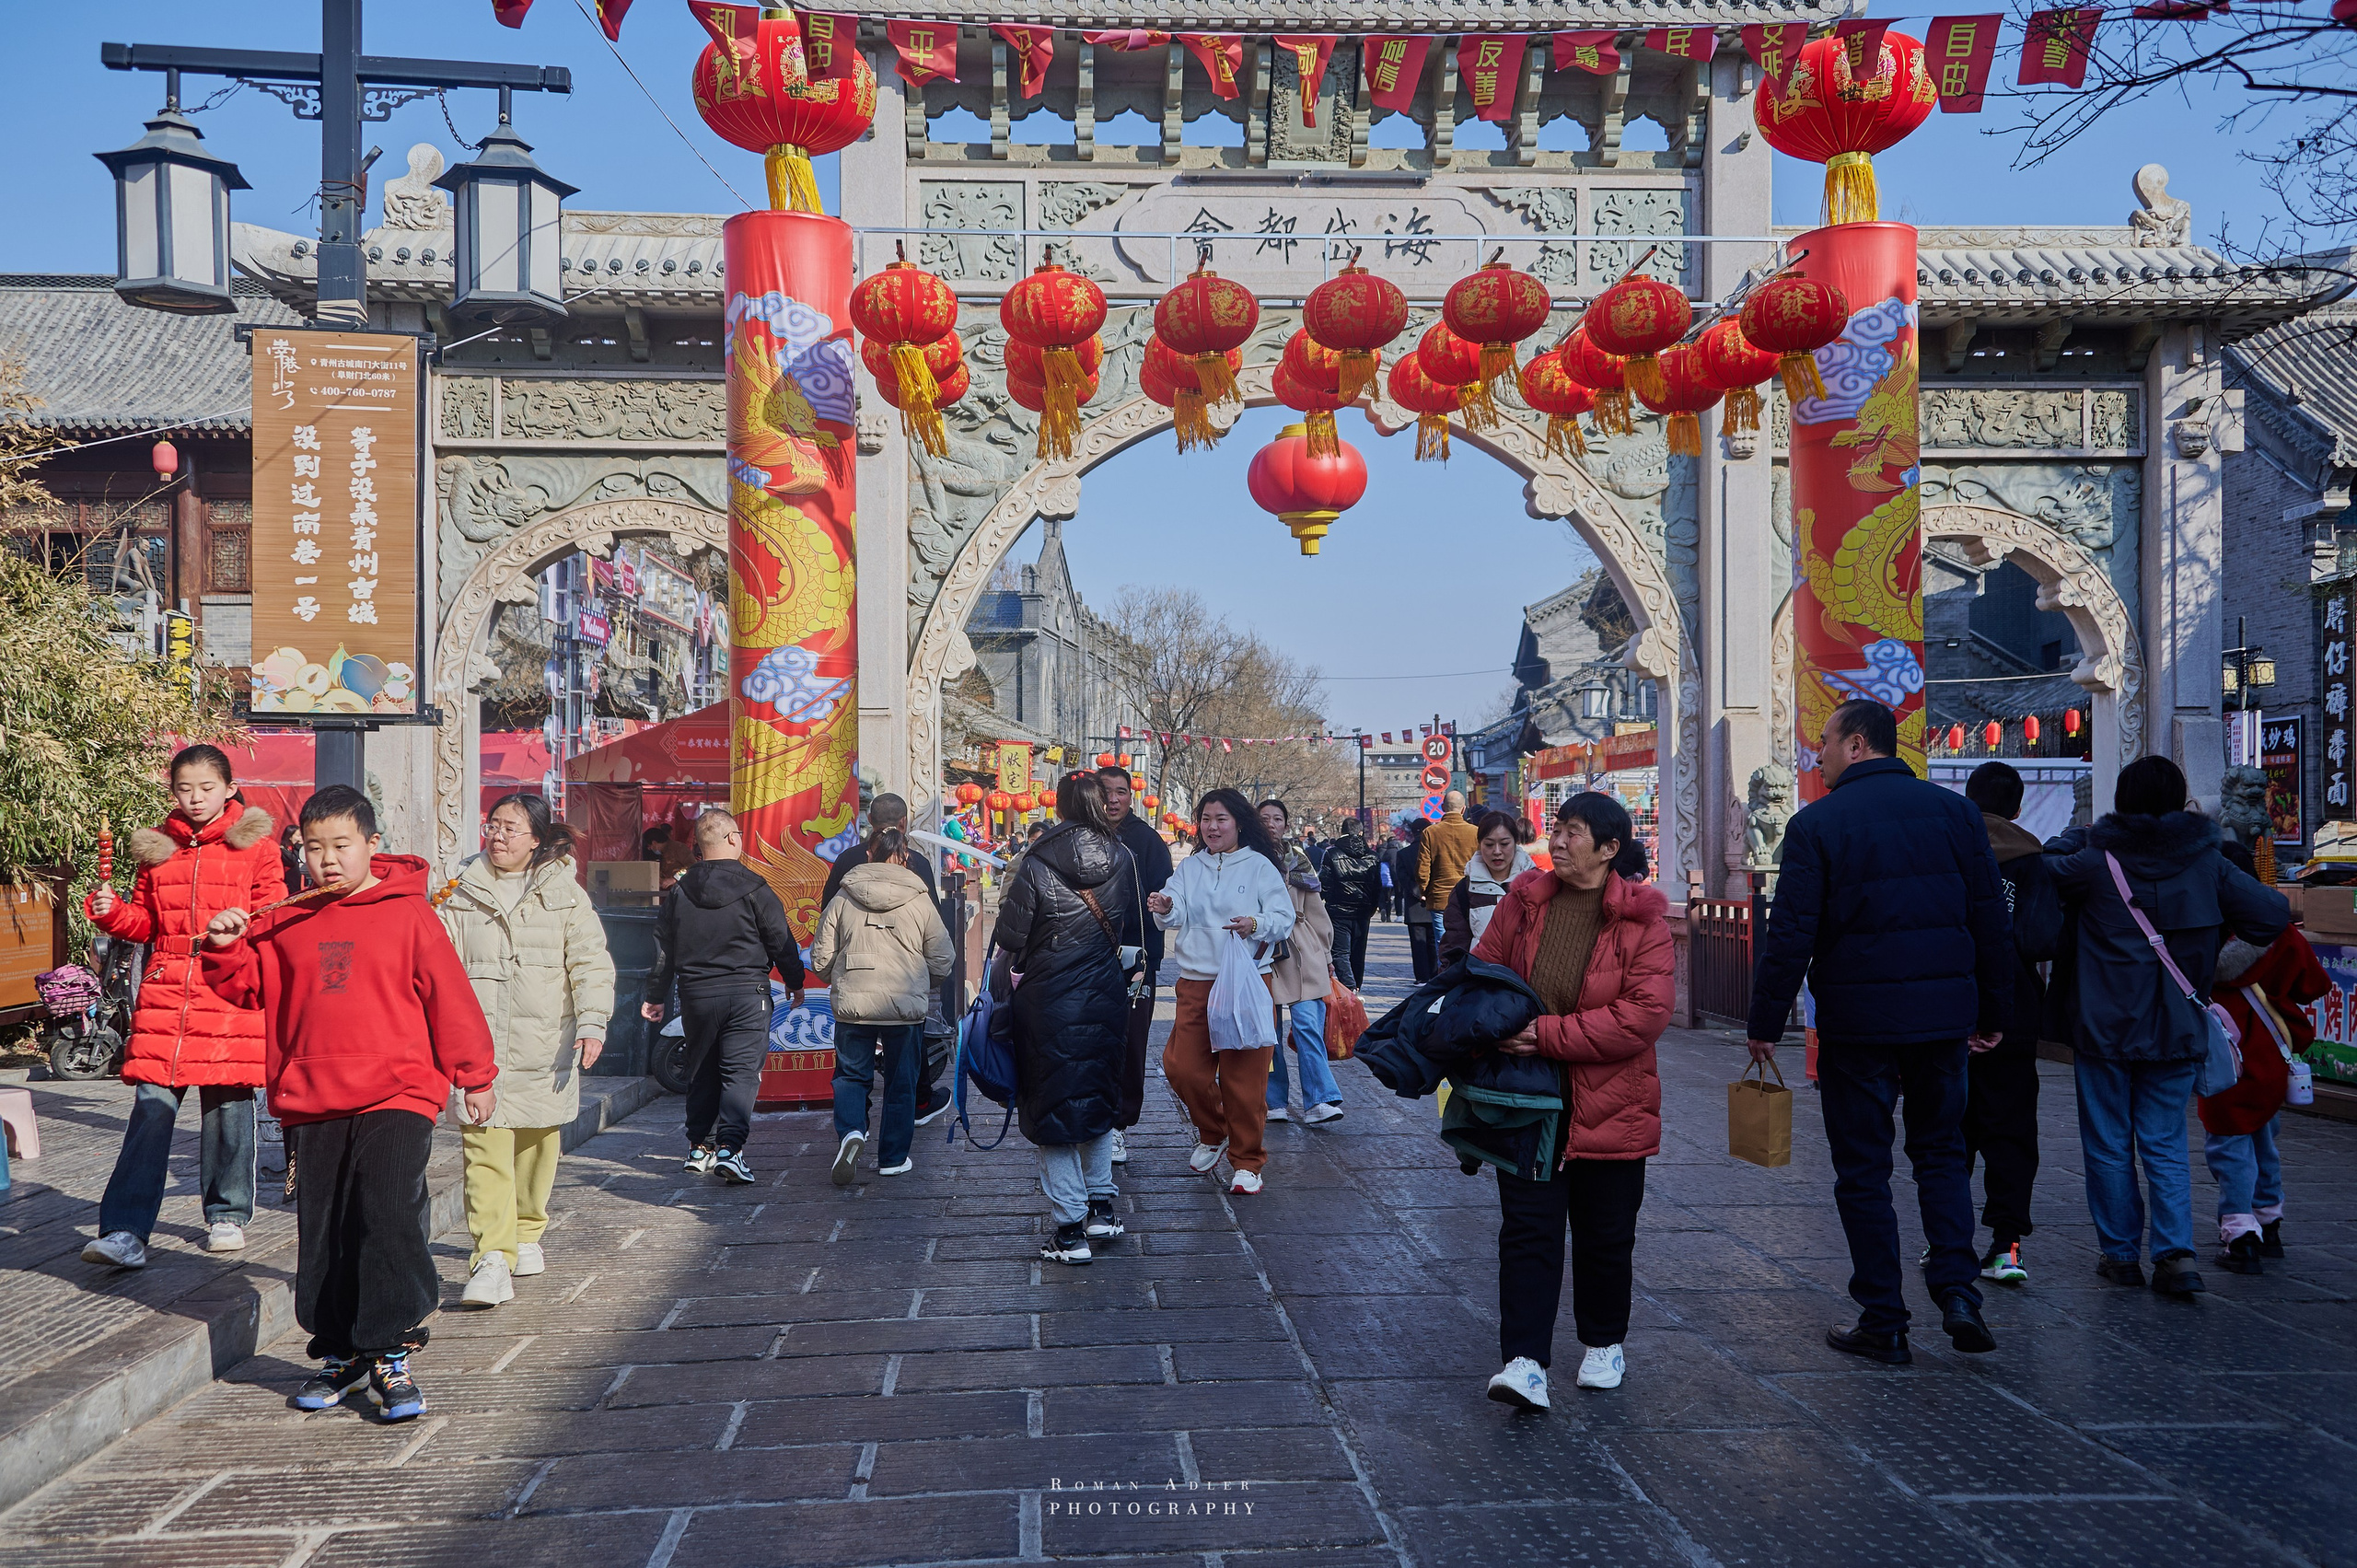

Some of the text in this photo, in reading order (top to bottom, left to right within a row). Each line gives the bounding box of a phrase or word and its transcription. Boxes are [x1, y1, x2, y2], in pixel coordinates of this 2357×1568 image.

[807, 14, 834, 70] 自由
[1373, 39, 1409, 93] 诚信
[1941, 22, 1977, 97] 自由
[1474, 40, 1504, 106] 友善
[320, 358, 407, 371] 青州古城南门大街11号
[320, 387, 396, 399] 400-760-0787
[290, 424, 322, 622] 没到过南巷一号
[347, 426, 378, 625] 等于没来青州古城
[1429, 741, 1446, 756] 20
[1080, 889, 1105, 919] SUNNY
